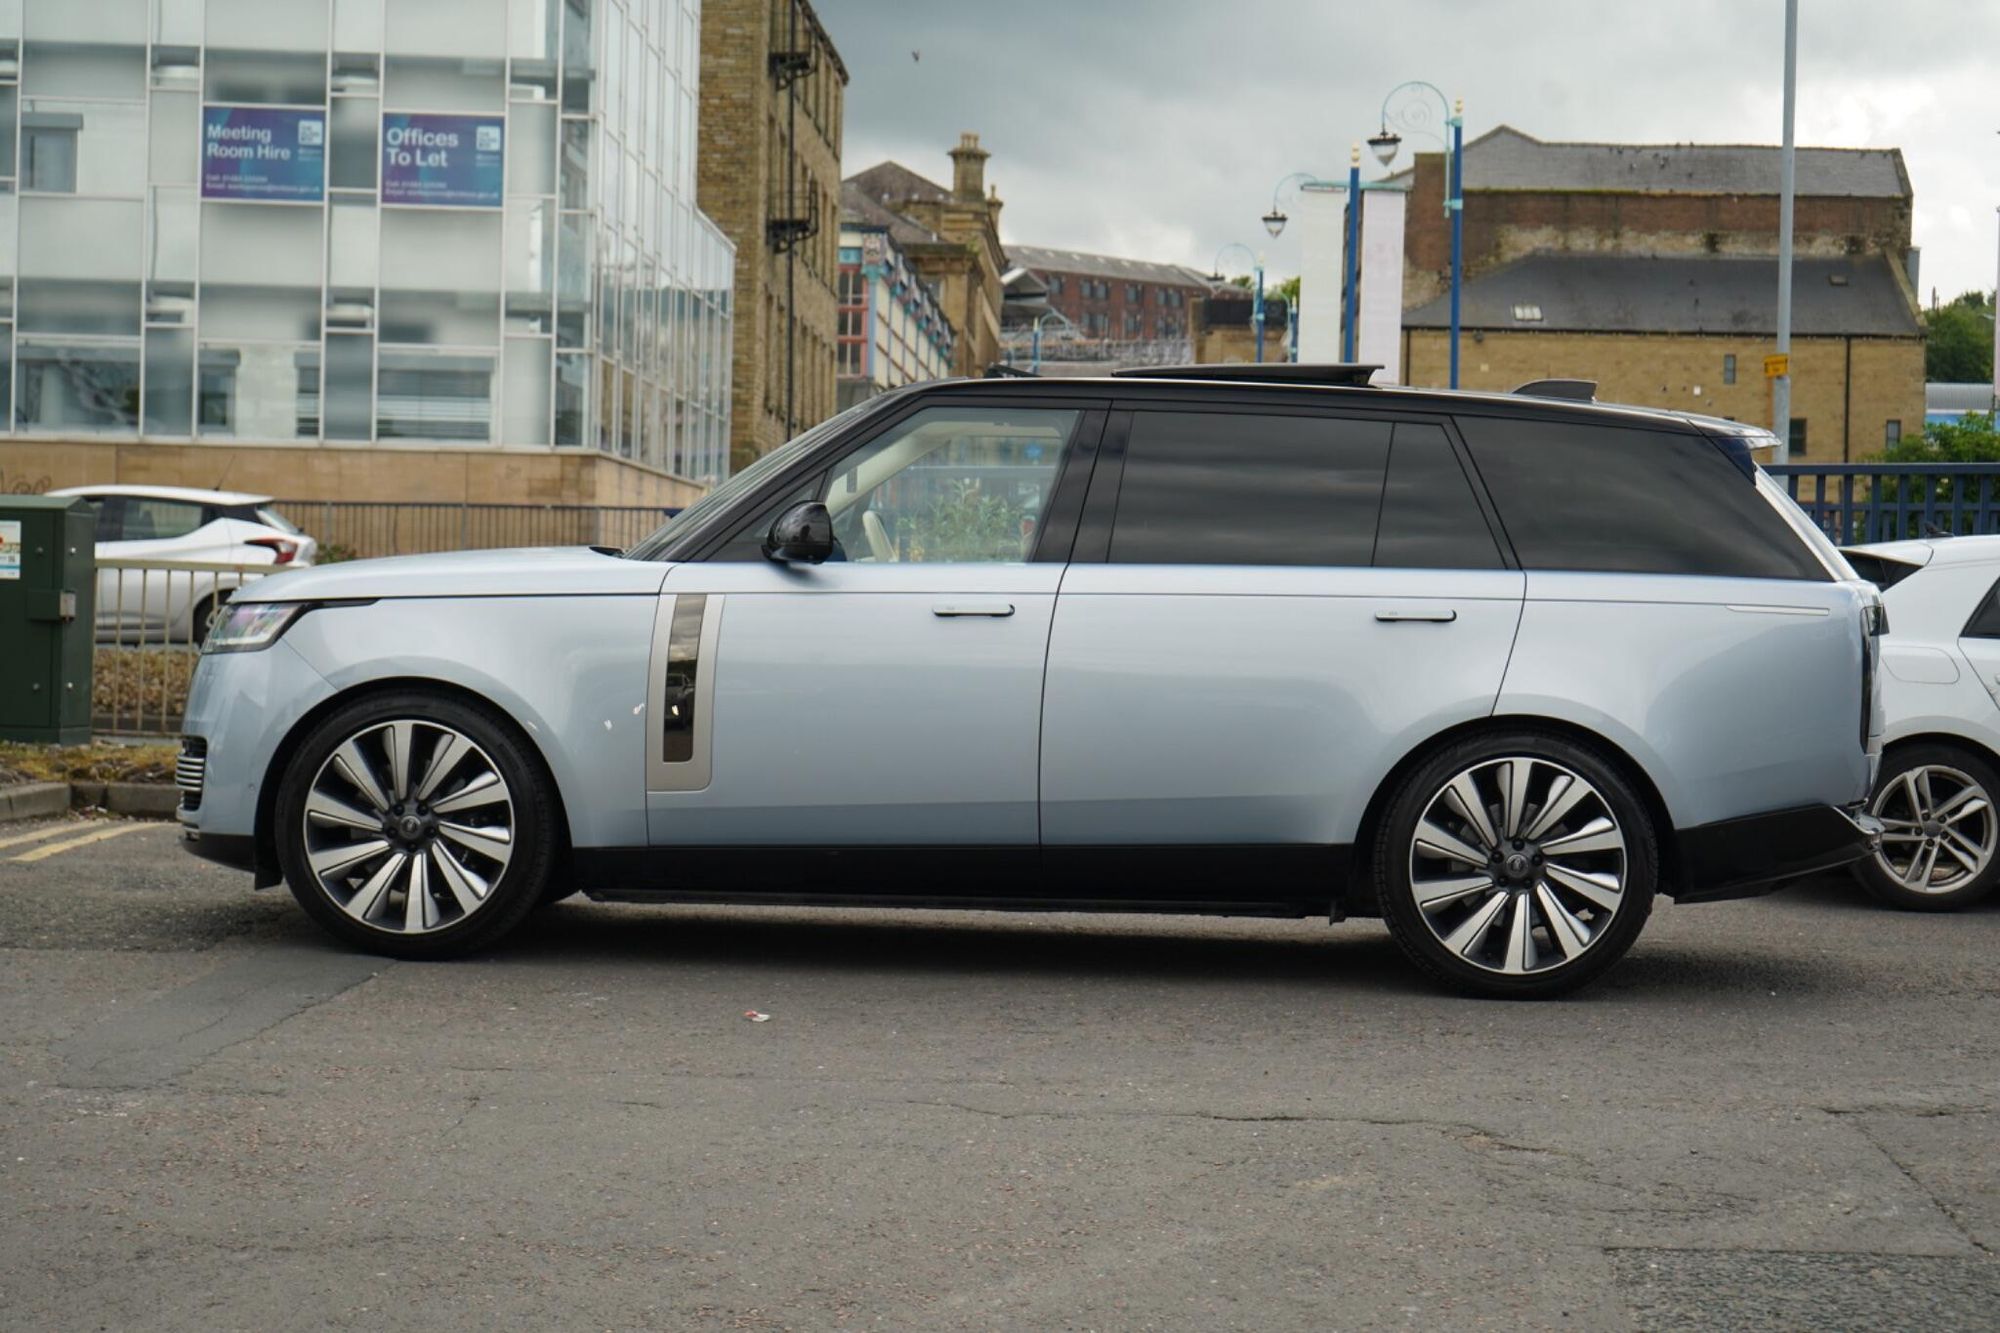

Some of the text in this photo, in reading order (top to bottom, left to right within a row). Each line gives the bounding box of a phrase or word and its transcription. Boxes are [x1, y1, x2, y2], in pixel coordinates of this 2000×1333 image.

[207, 123, 272, 145] Meeting
[386, 127, 459, 148] Offices
[207, 142, 254, 158] Room
[257, 144, 291, 161] Hire
[386, 147, 449, 168] To Let
